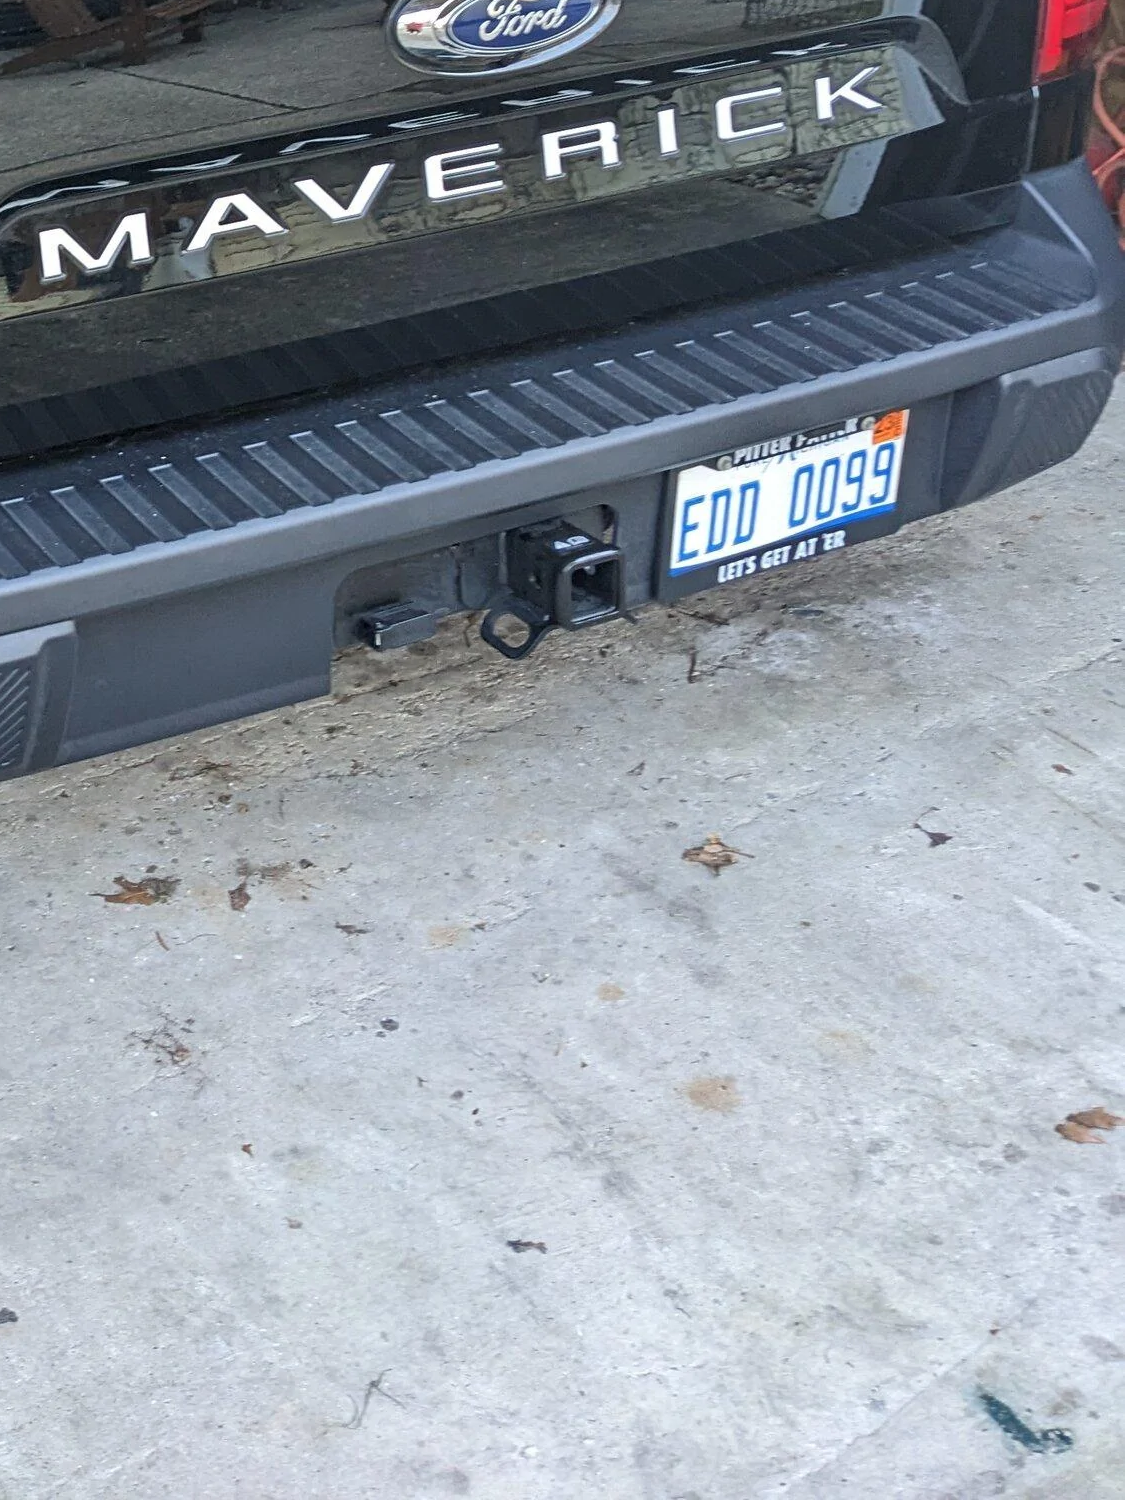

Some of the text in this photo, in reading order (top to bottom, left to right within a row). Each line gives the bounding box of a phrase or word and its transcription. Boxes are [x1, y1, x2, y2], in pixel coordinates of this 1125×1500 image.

[39, 66, 883, 283] MAVERICK
[678, 479, 761, 563] EDD
[789, 441, 896, 529] 0099
[760, 545, 791, 570] GET
[794, 537, 819, 561] AT
